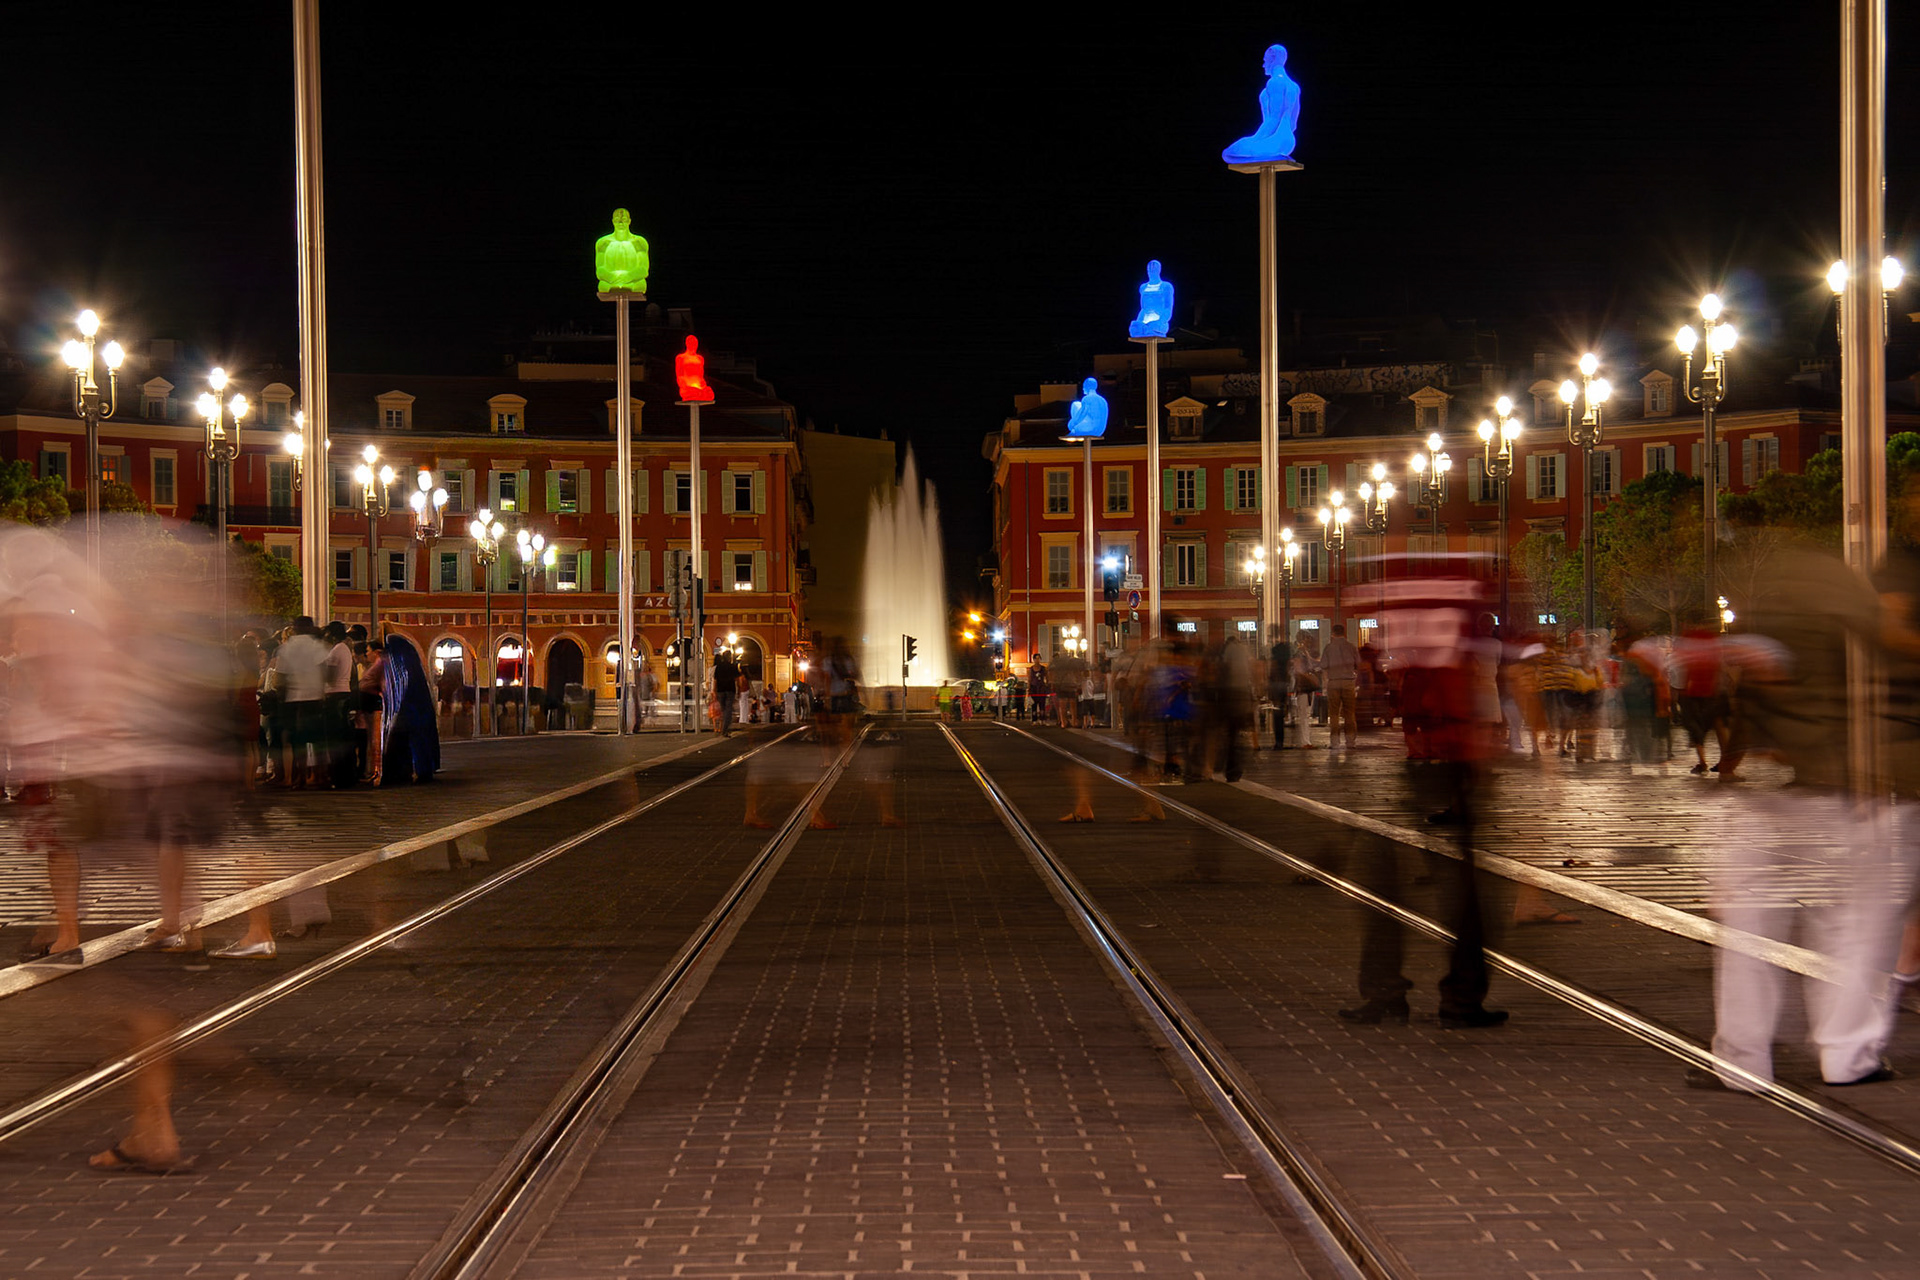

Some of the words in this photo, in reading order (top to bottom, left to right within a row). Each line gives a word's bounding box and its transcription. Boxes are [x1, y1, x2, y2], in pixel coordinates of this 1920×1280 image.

[1177, 622, 1196, 632] HOTEL
[1238, 621, 1256, 631] HOTEL
[1300, 620, 1319, 630] HOTEL
[1360, 618, 1378, 628] HOTEL
